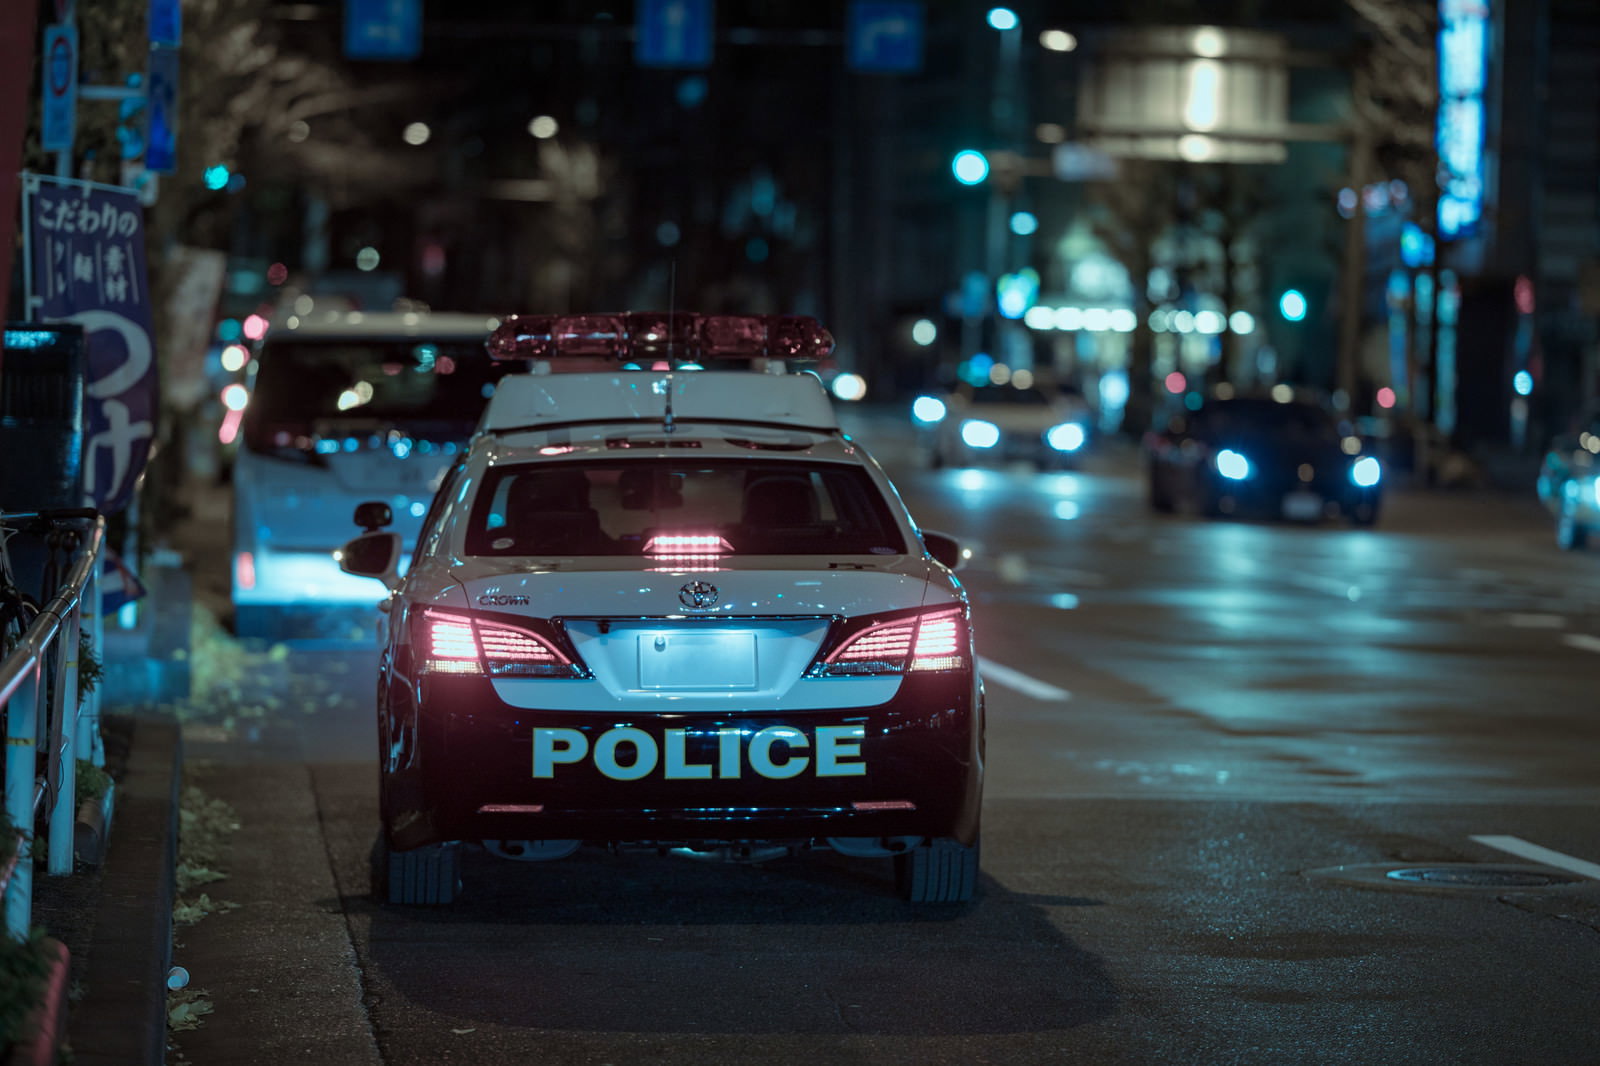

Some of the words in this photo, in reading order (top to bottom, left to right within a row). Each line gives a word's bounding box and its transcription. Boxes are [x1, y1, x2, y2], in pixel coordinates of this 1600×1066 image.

[38, 198, 139, 240] こだわりの
[104, 244, 129, 303] 素材
[479, 594, 530, 606] CROWN
[532, 725, 867, 780] POLICE
